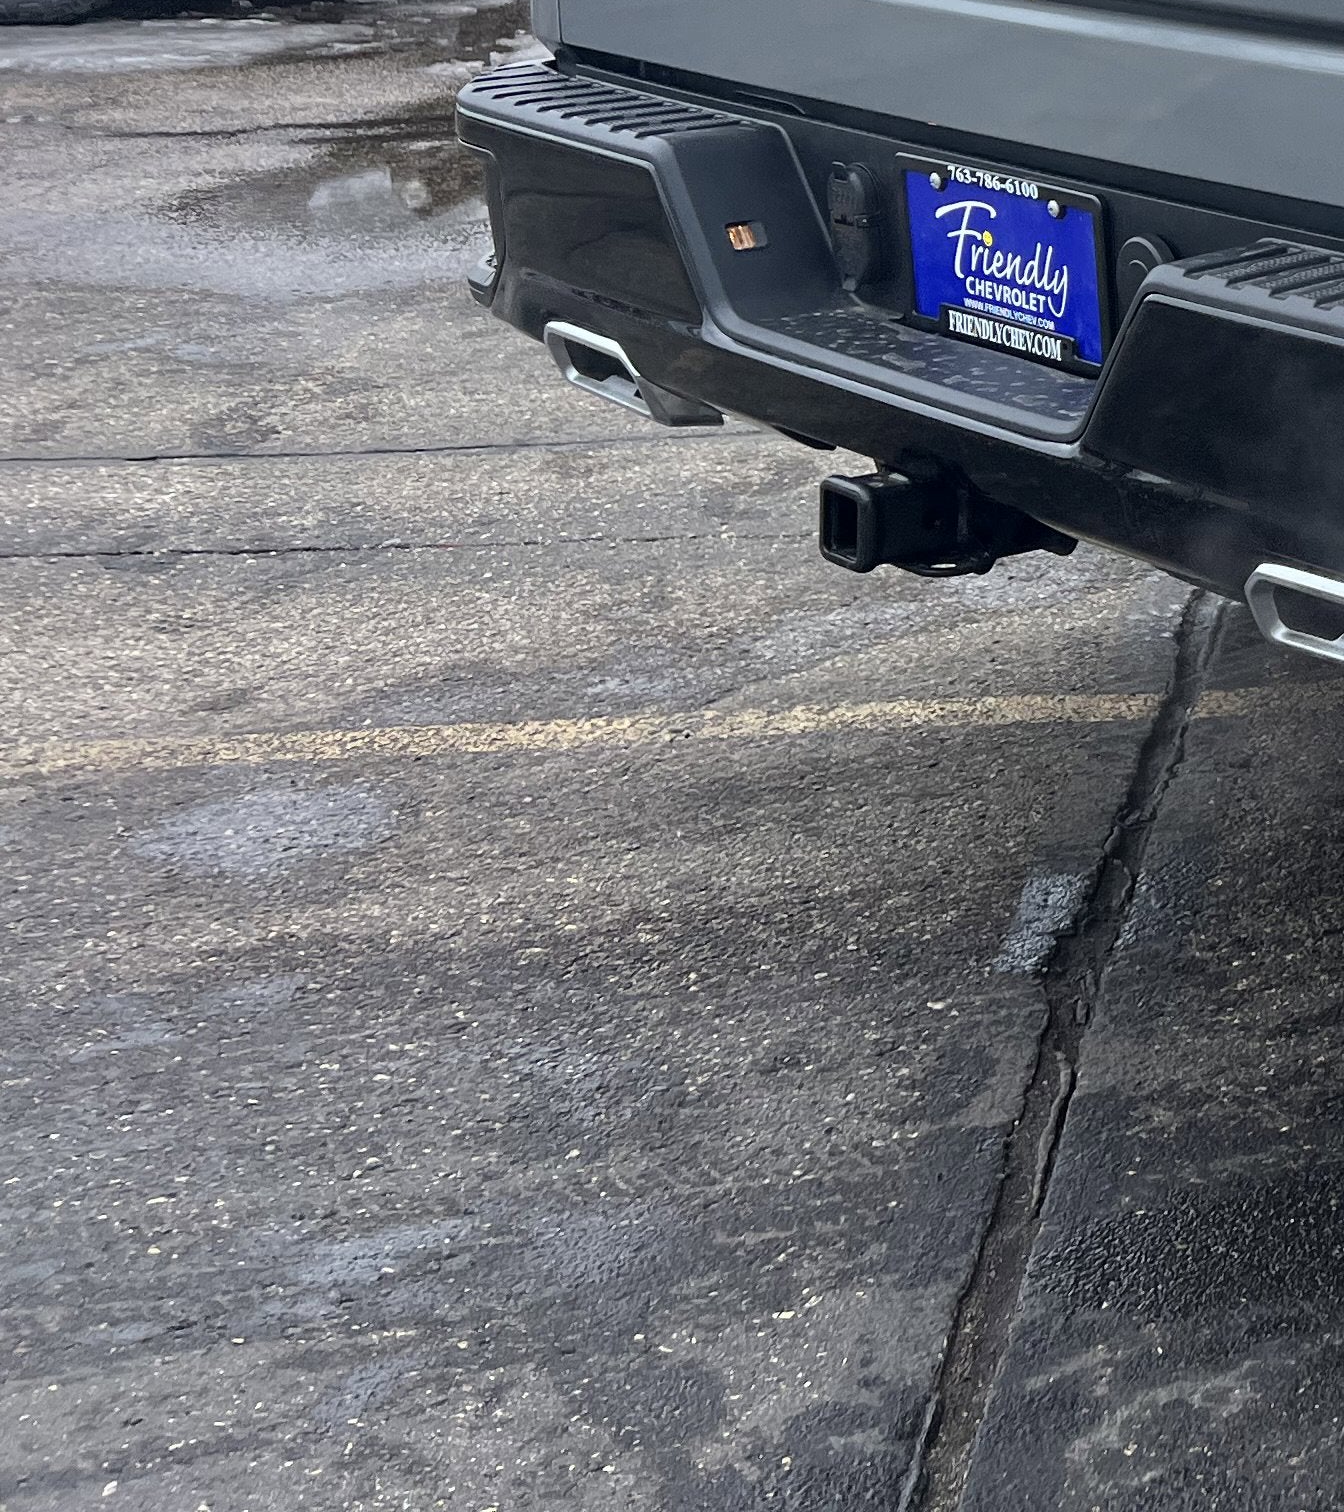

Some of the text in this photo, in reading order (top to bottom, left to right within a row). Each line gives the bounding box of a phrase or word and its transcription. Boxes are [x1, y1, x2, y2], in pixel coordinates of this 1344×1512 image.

[947, 164, 1039, 200] 763-786-6100
[935, 200, 1068, 318] Friendly
[965, 275, 1047, 314] CHEVROLET
[948, 310, 1062, 362] FRIENDLYCHEV.COM
